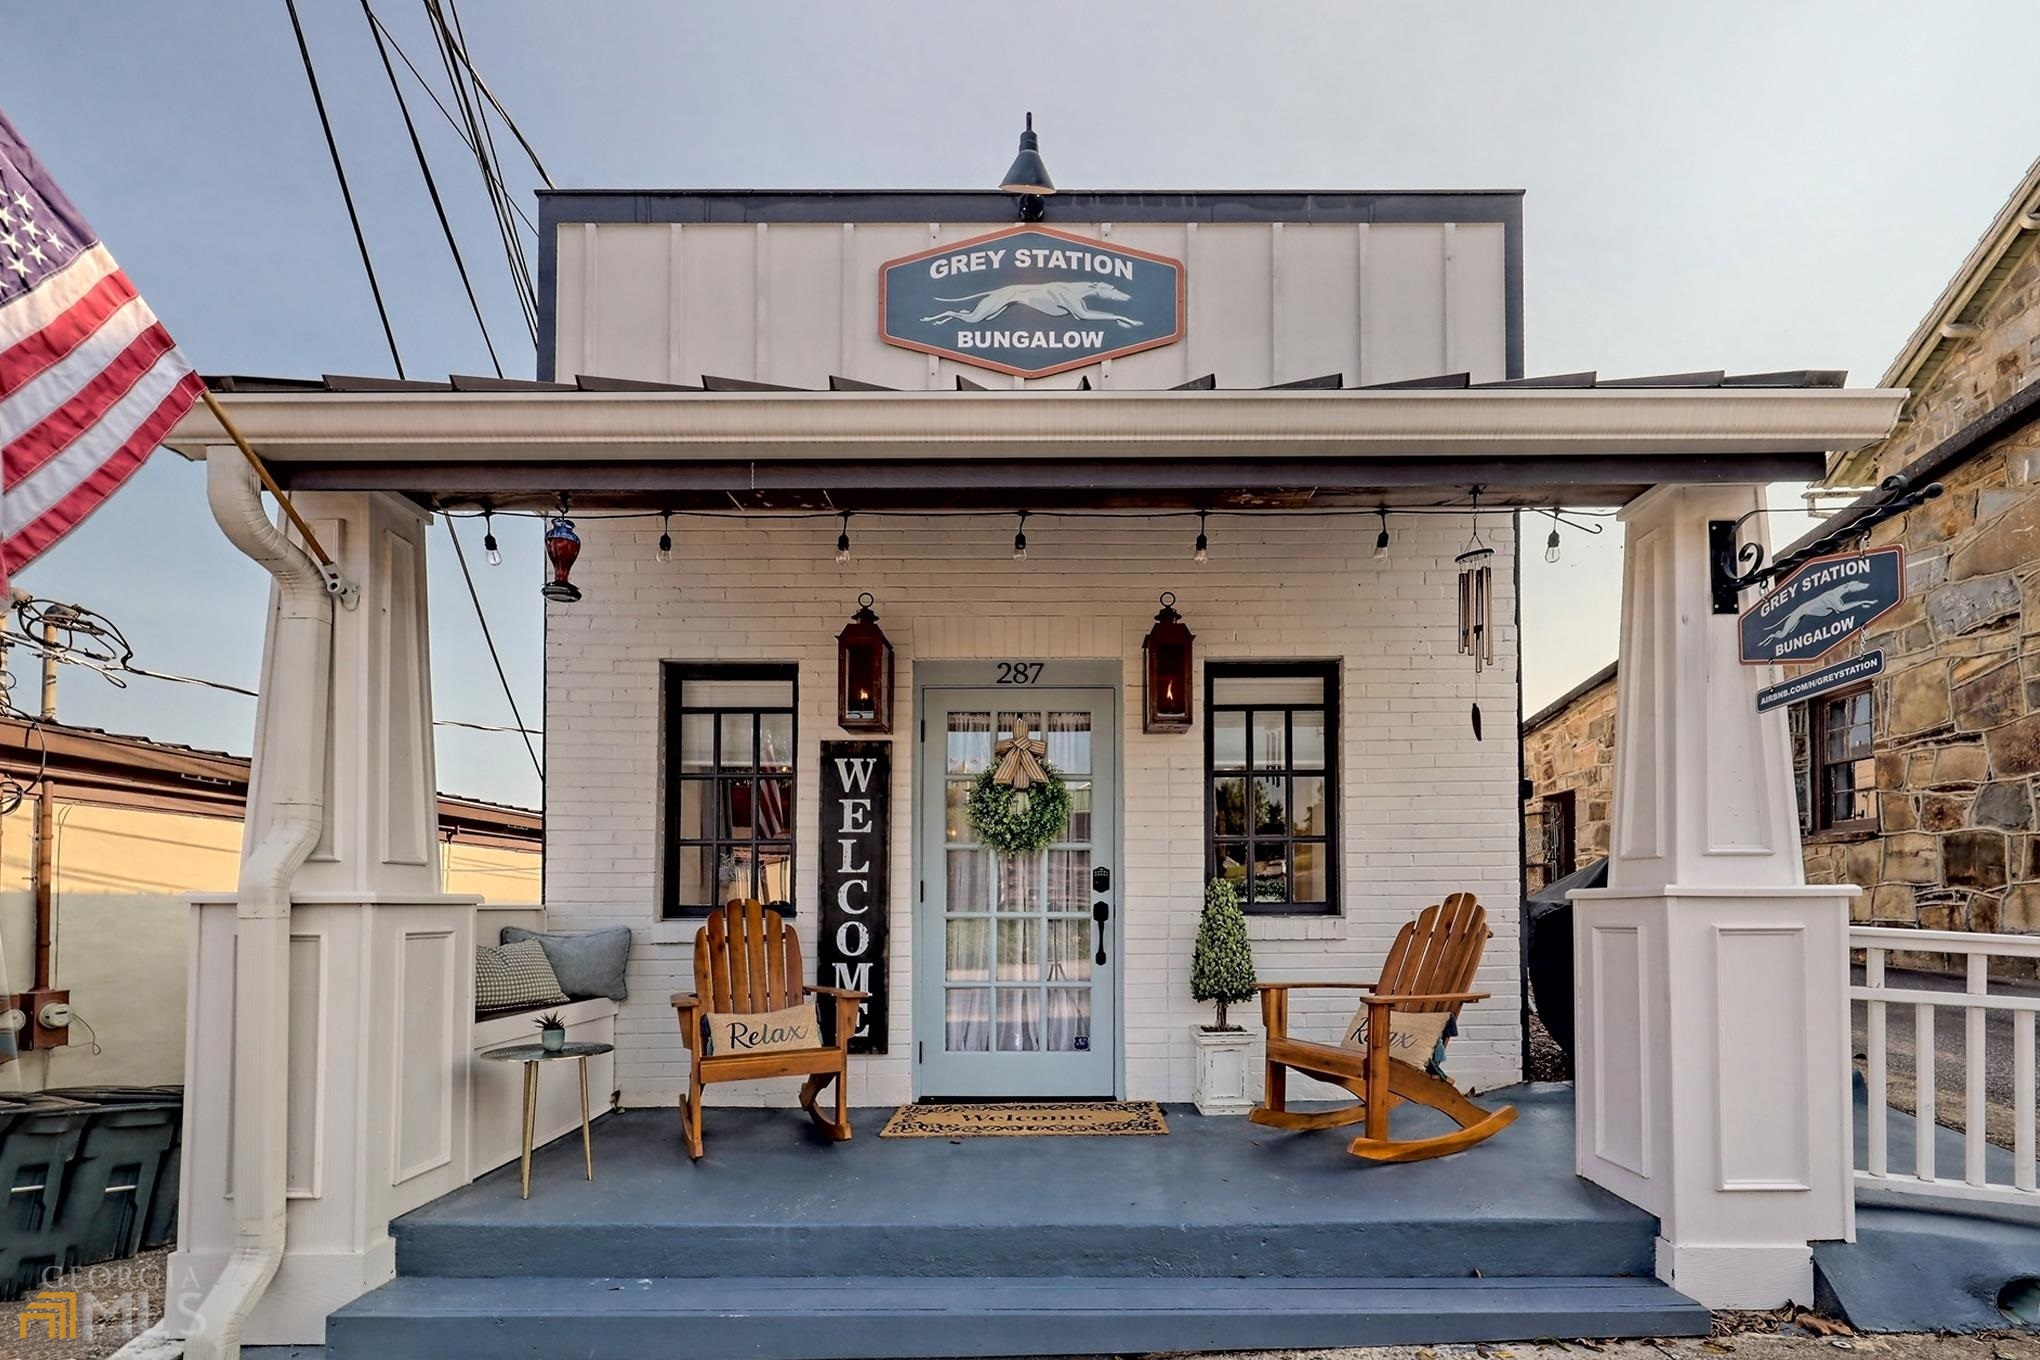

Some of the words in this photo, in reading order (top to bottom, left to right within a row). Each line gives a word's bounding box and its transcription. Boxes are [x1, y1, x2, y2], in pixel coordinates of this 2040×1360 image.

[929, 249, 1006, 280] GREY
[1014, 248, 1134, 280] STATION
[957, 330, 1105, 349] BUNGALOW
[1760, 583, 1799, 618] GREY
[1802, 559, 1871, 592] STATION
[1775, 615, 1856, 657] BUNGALOW
[996, 662, 1045, 684] 287
[1760, 658, 1878, 705] AIRBNB.COM/H/GREYSTATION
[725, 1021, 808, 1050] Relax
[962, 1113, 1093, 1122] Welcome
